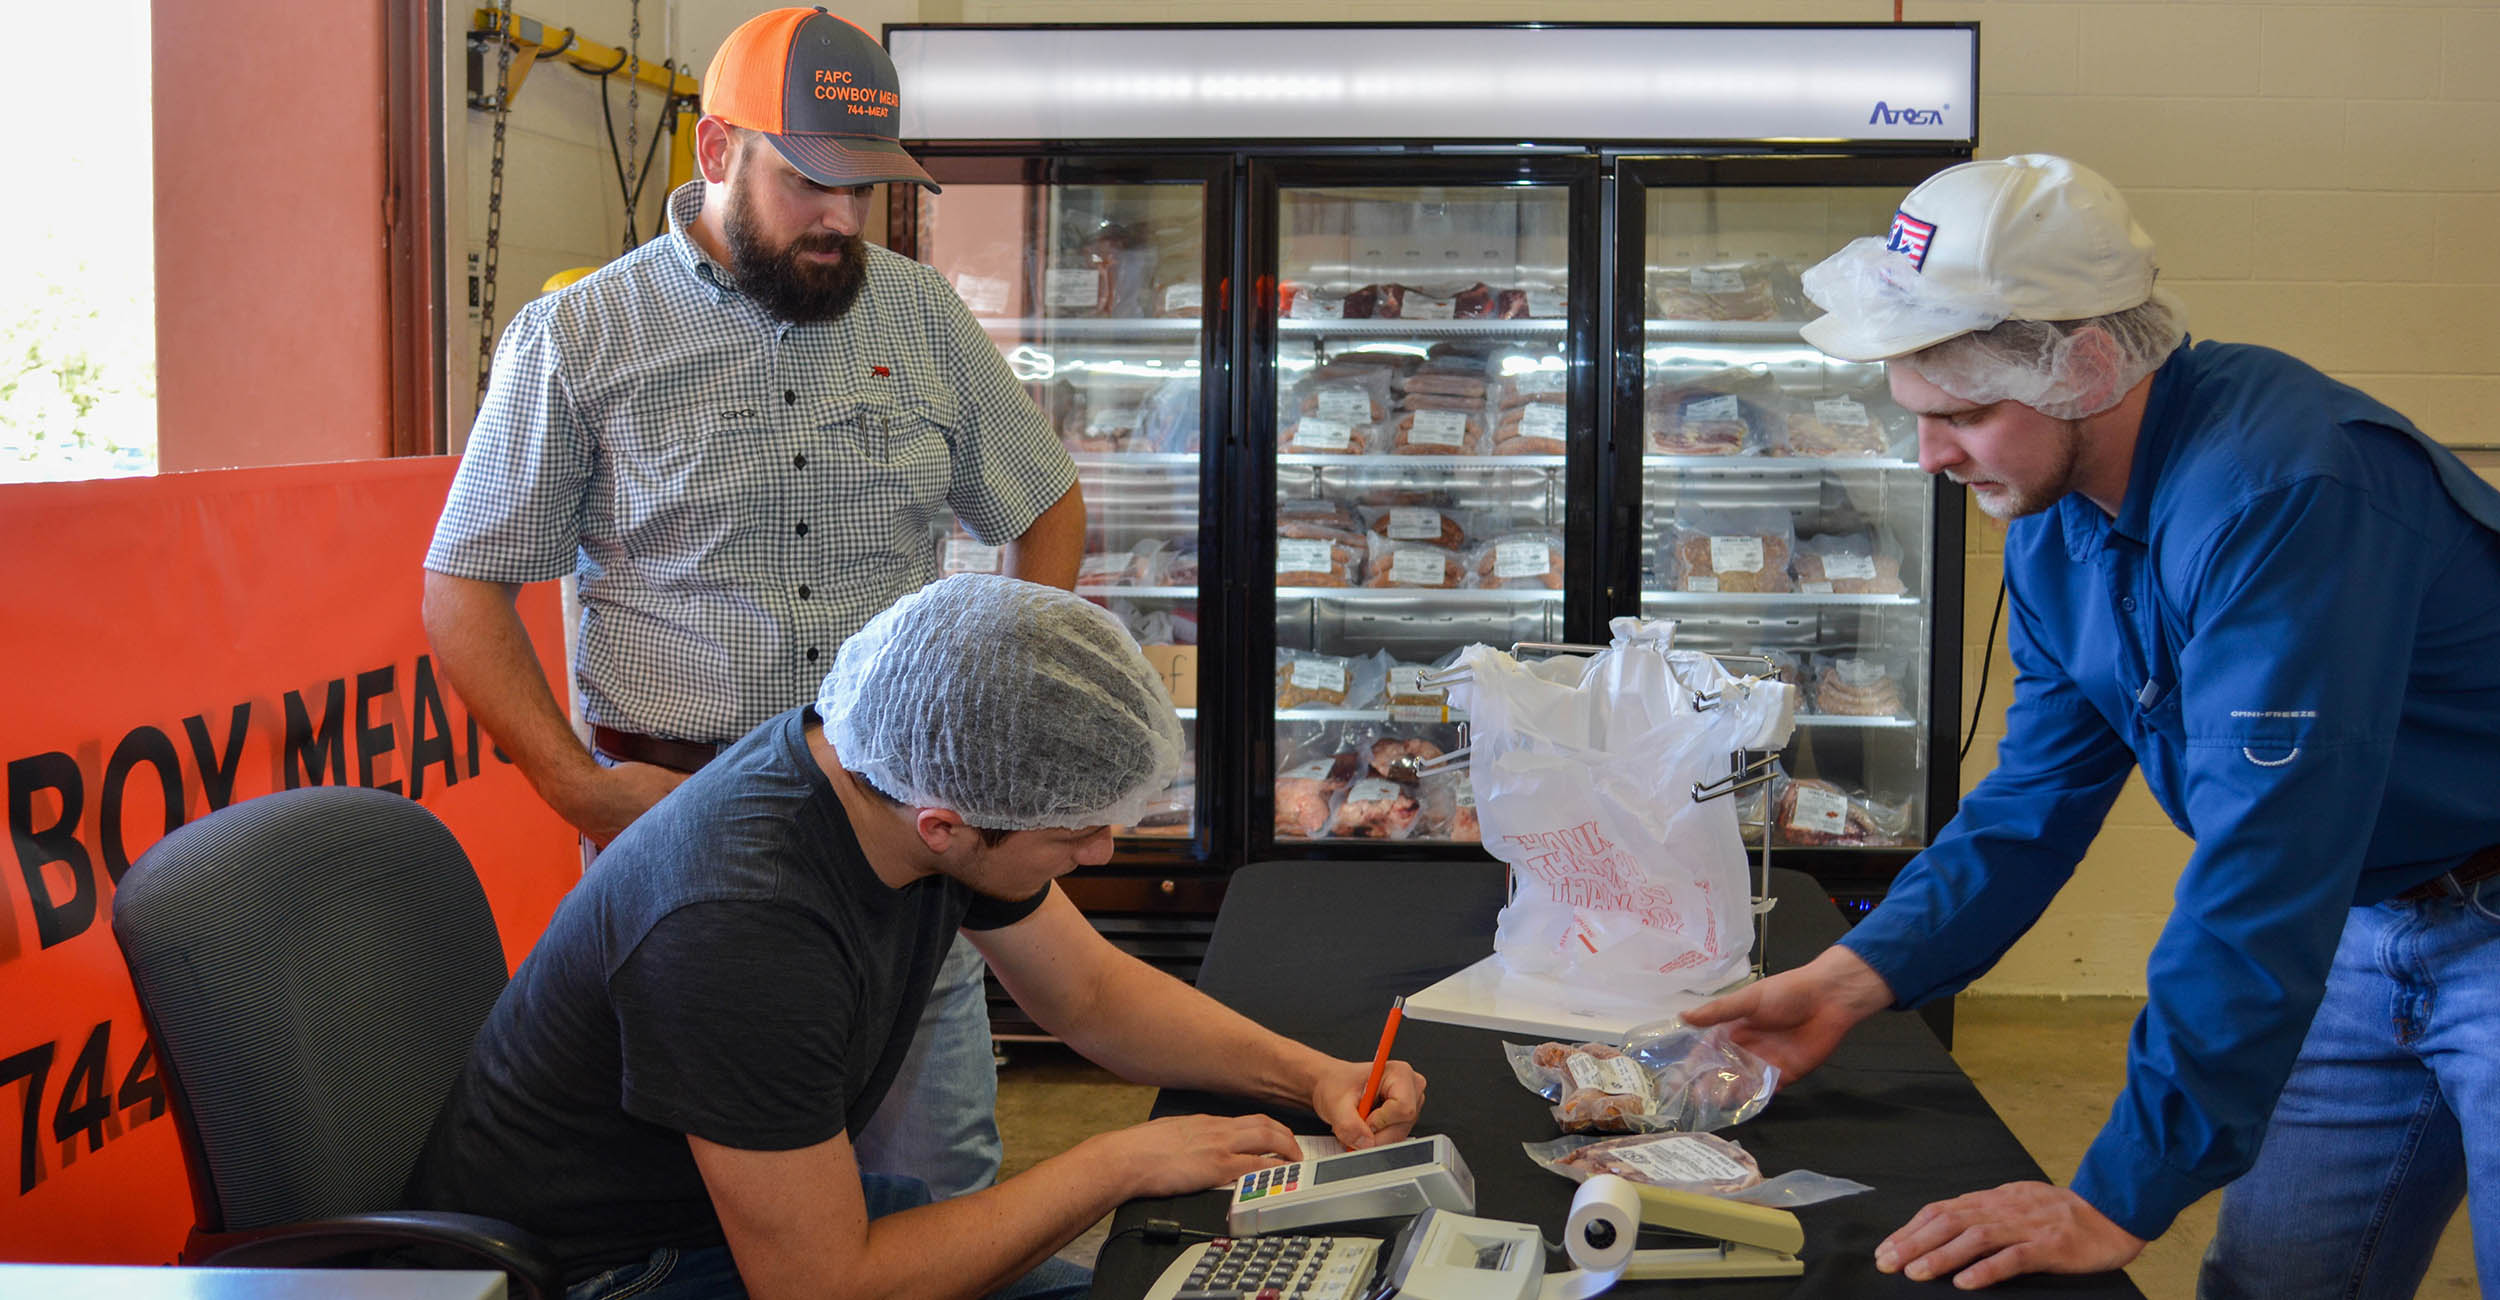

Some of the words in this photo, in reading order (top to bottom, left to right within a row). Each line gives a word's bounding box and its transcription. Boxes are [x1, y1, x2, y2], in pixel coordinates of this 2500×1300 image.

[815, 70, 852, 84] FAPC
[814, 85, 877, 103] COWBOY
[847, 104, 888, 117] 744-MEAT
[2230, 710, 2317, 718] OMNI-FREEZE
[283, 654, 513, 801] MEA
